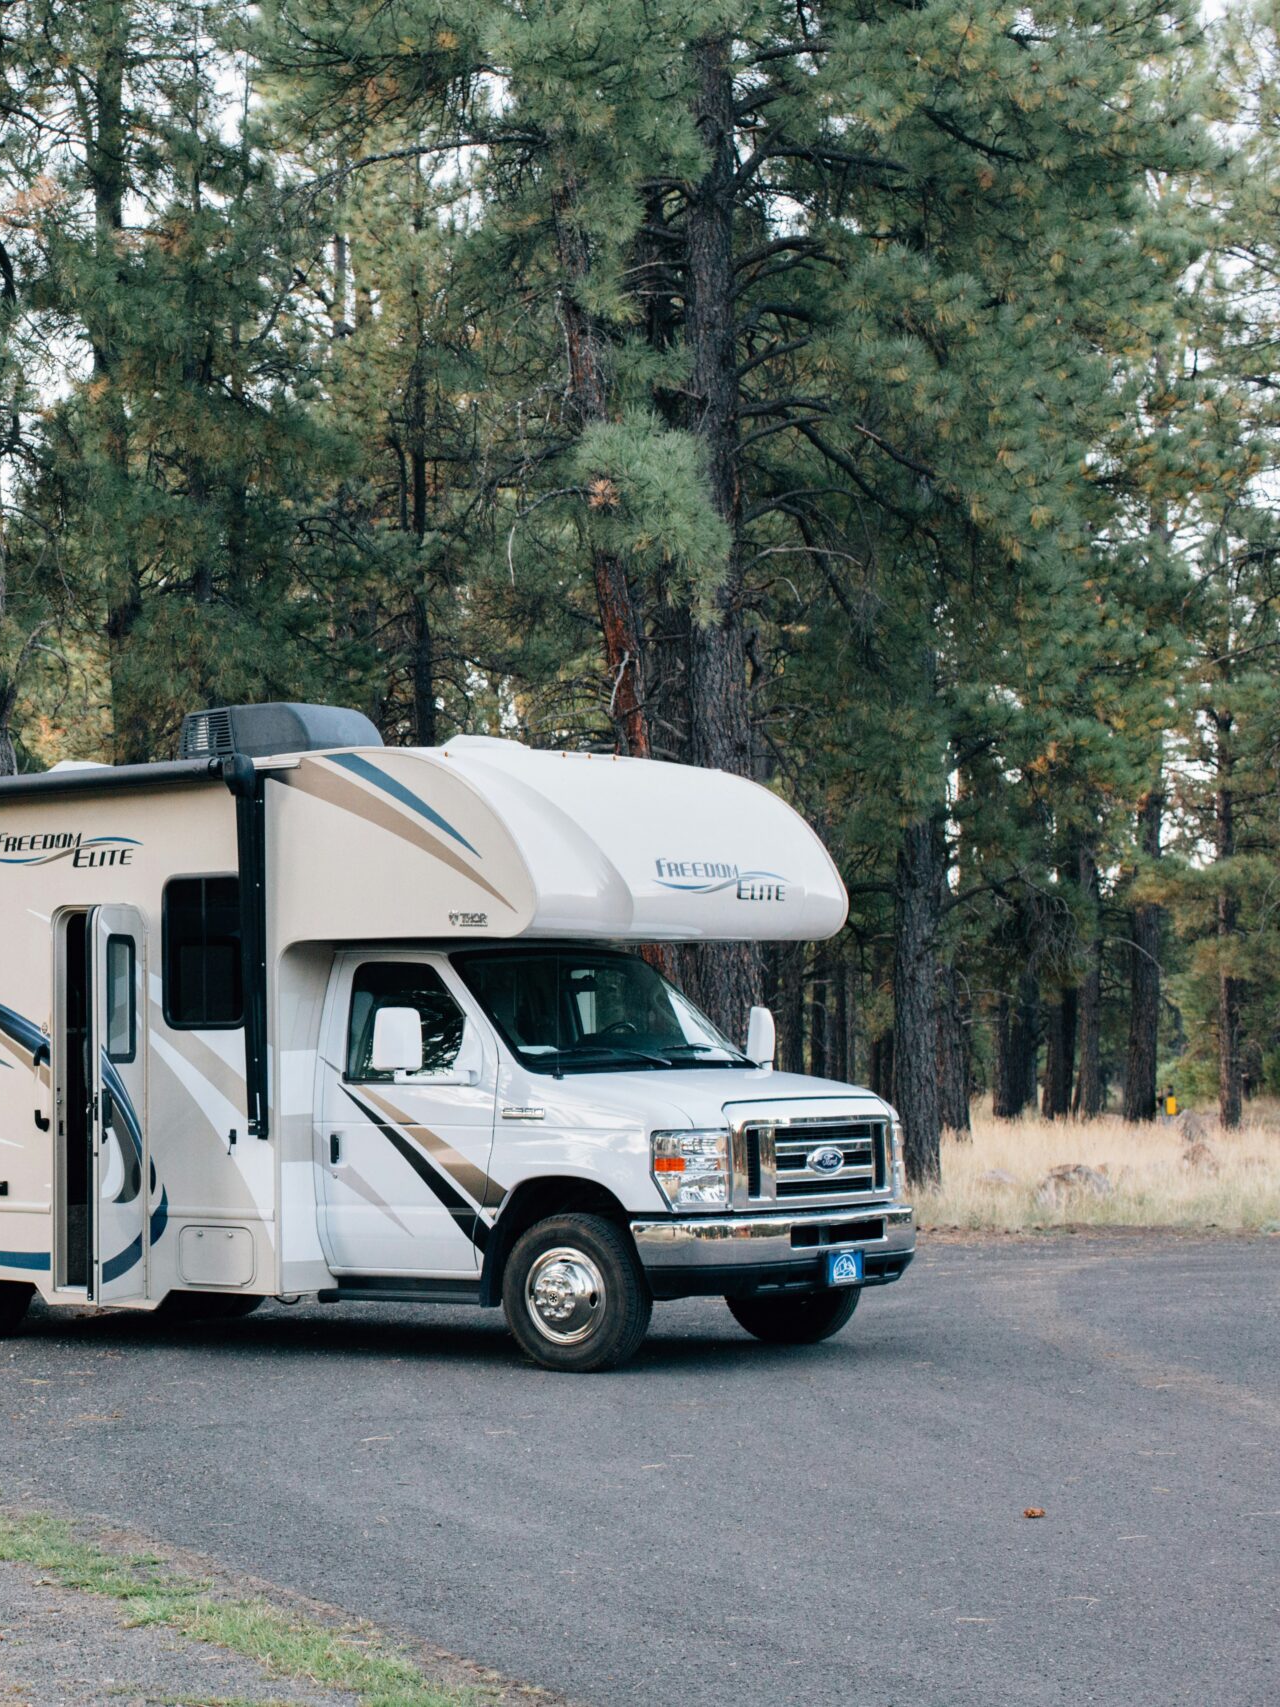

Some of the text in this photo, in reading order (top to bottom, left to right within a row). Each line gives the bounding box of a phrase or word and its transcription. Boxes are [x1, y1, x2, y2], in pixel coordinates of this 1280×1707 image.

[72, 847, 134, 868] ELITE
[655, 857, 739, 878] FREEDOM
[736, 879, 786, 901] ELITE
